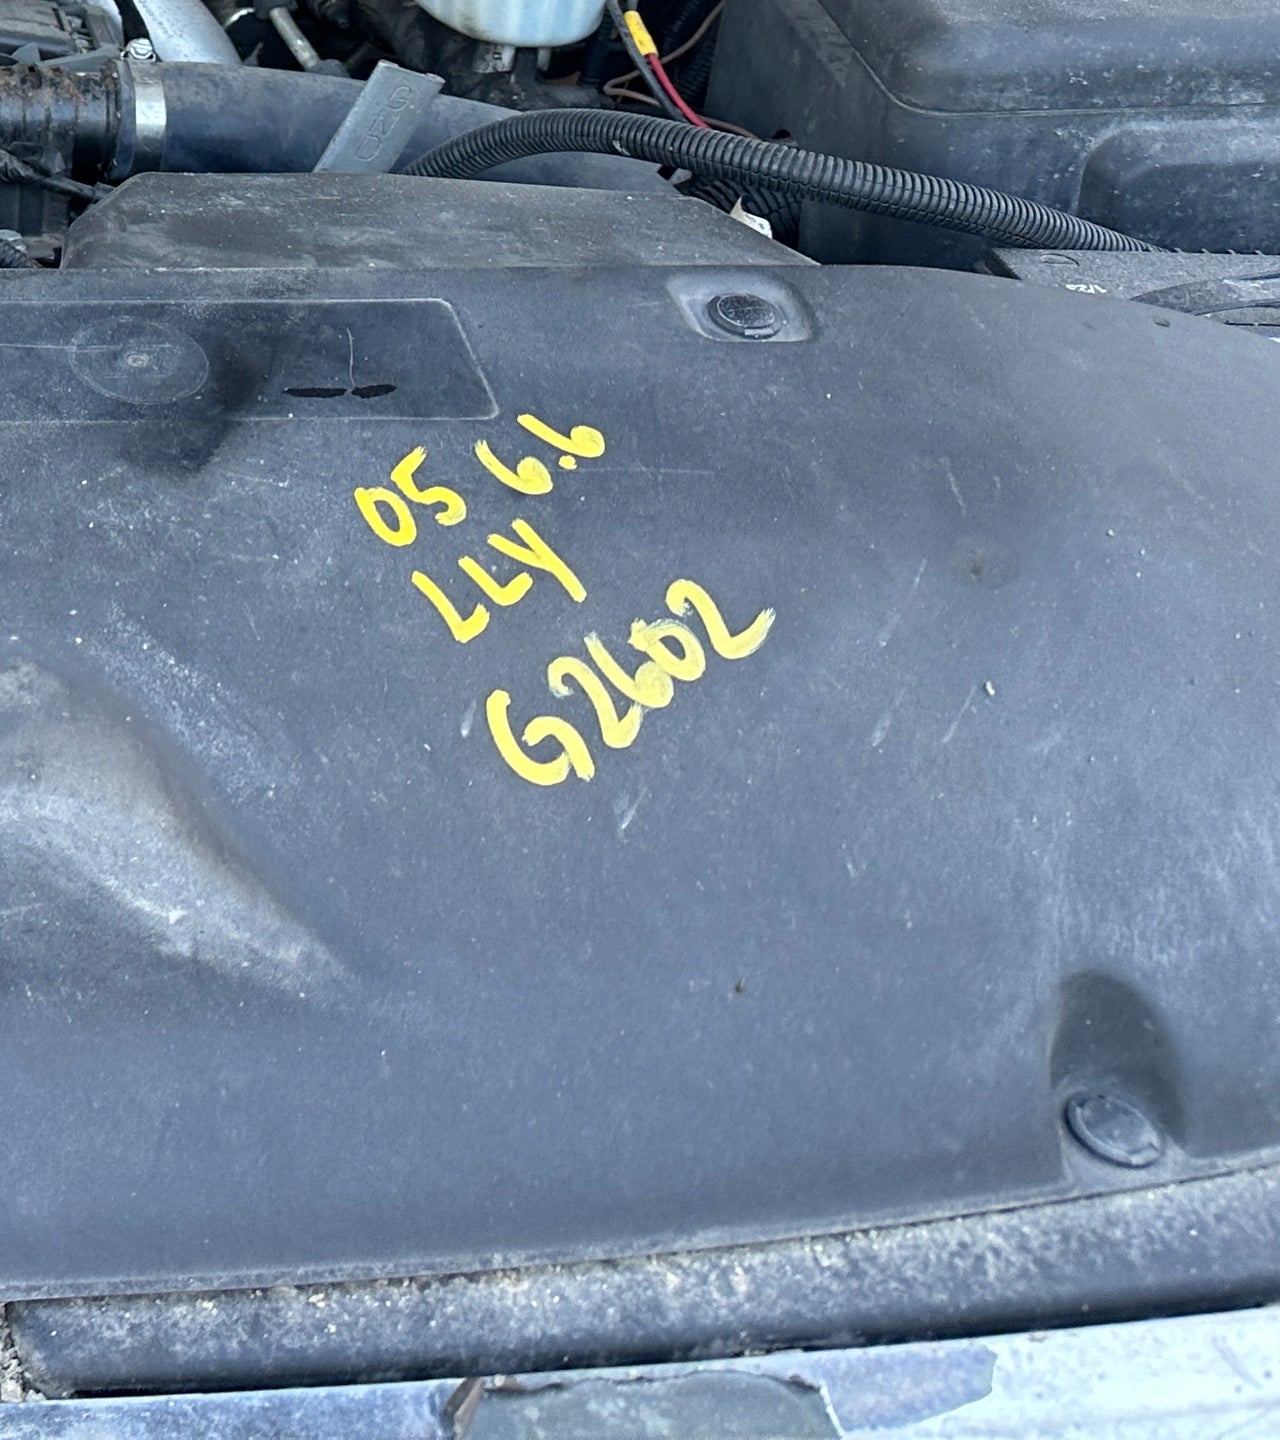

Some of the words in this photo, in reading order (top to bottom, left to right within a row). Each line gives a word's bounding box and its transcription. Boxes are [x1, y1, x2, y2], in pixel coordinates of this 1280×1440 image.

[353, 85, 412, 162] GND
[353, 445, 467, 547] 05
[474, 413, 606, 496] 6.6
[411, 518, 588, 644] LLY
[486, 578, 777, 786] G2602
